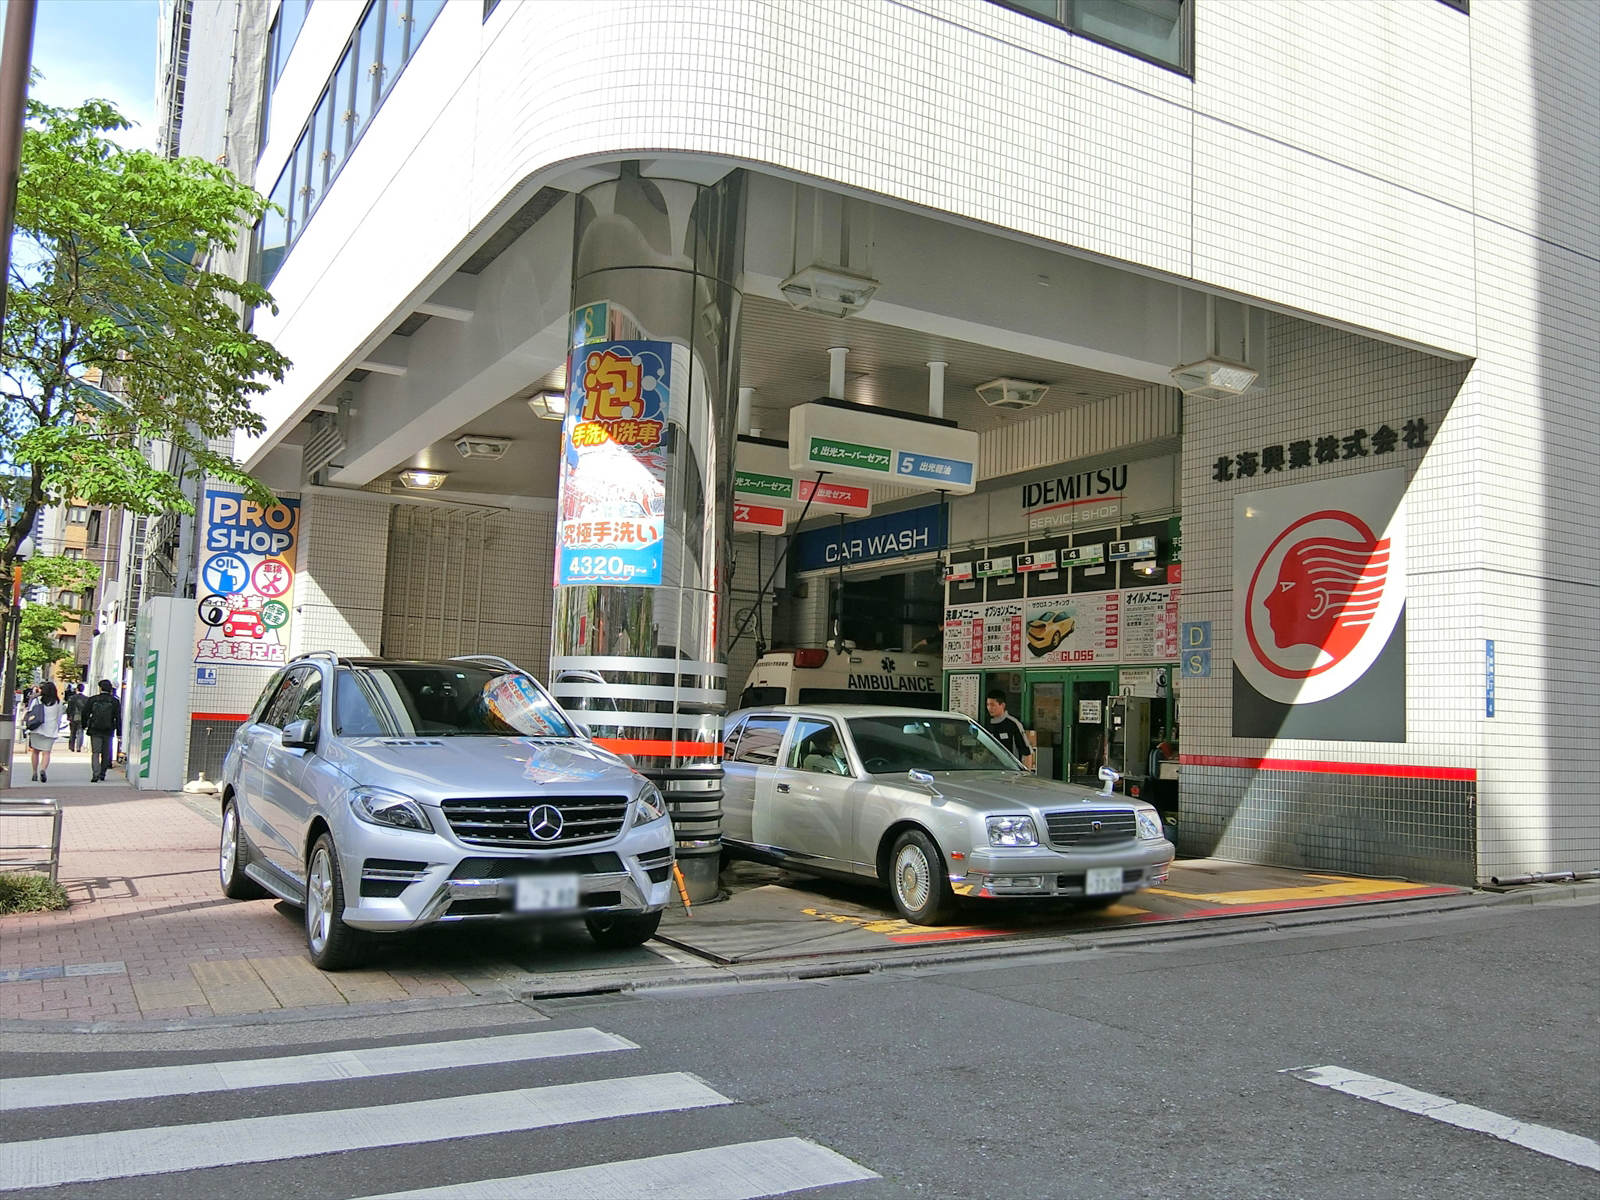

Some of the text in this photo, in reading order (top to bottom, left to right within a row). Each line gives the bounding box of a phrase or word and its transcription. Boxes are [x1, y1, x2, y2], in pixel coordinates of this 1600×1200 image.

[583, 352, 642, 420] 泡
[572, 421, 661, 446] 手洗い洗車
[811, 446, 889, 466] 4 出光スーパーゼアス
[1212, 418, 1429, 482] 北海興業株式会社
[900, 457, 952, 476] 5 出光軽油
[734, 477, 791, 492] 光スーパーゼアス
[801, 487, 852, 500] 3 出光ゼアス
[1022, 465, 1129, 509] IDEMITSU
[212, 497, 292, 528] PRO
[1029, 505, 1119, 529] SERVICE SHOP
[211, 529, 290, 553] SHOP
[563, 520, 657, 544] 究極手洗い
[825, 527, 929, 563] CAR WASH
[1069, 550, 1077, 559] 4
[1118, 543, 1126, 553] 5
[215, 558, 239, 570] OIL
[262, 563, 284, 575] 車検
[983, 563, 990, 571] 2
[1024, 556, 1032, 565] 3
[227, 593, 263, 611] 洗車
[1126, 591, 1169, 605] オイルメニュー
[1190, 626, 1203, 647] D
[197, 639, 287, 662] 愛車満足店
[1189, 656, 1202, 675] S
[847, 673, 936, 692] AMBULANCE
